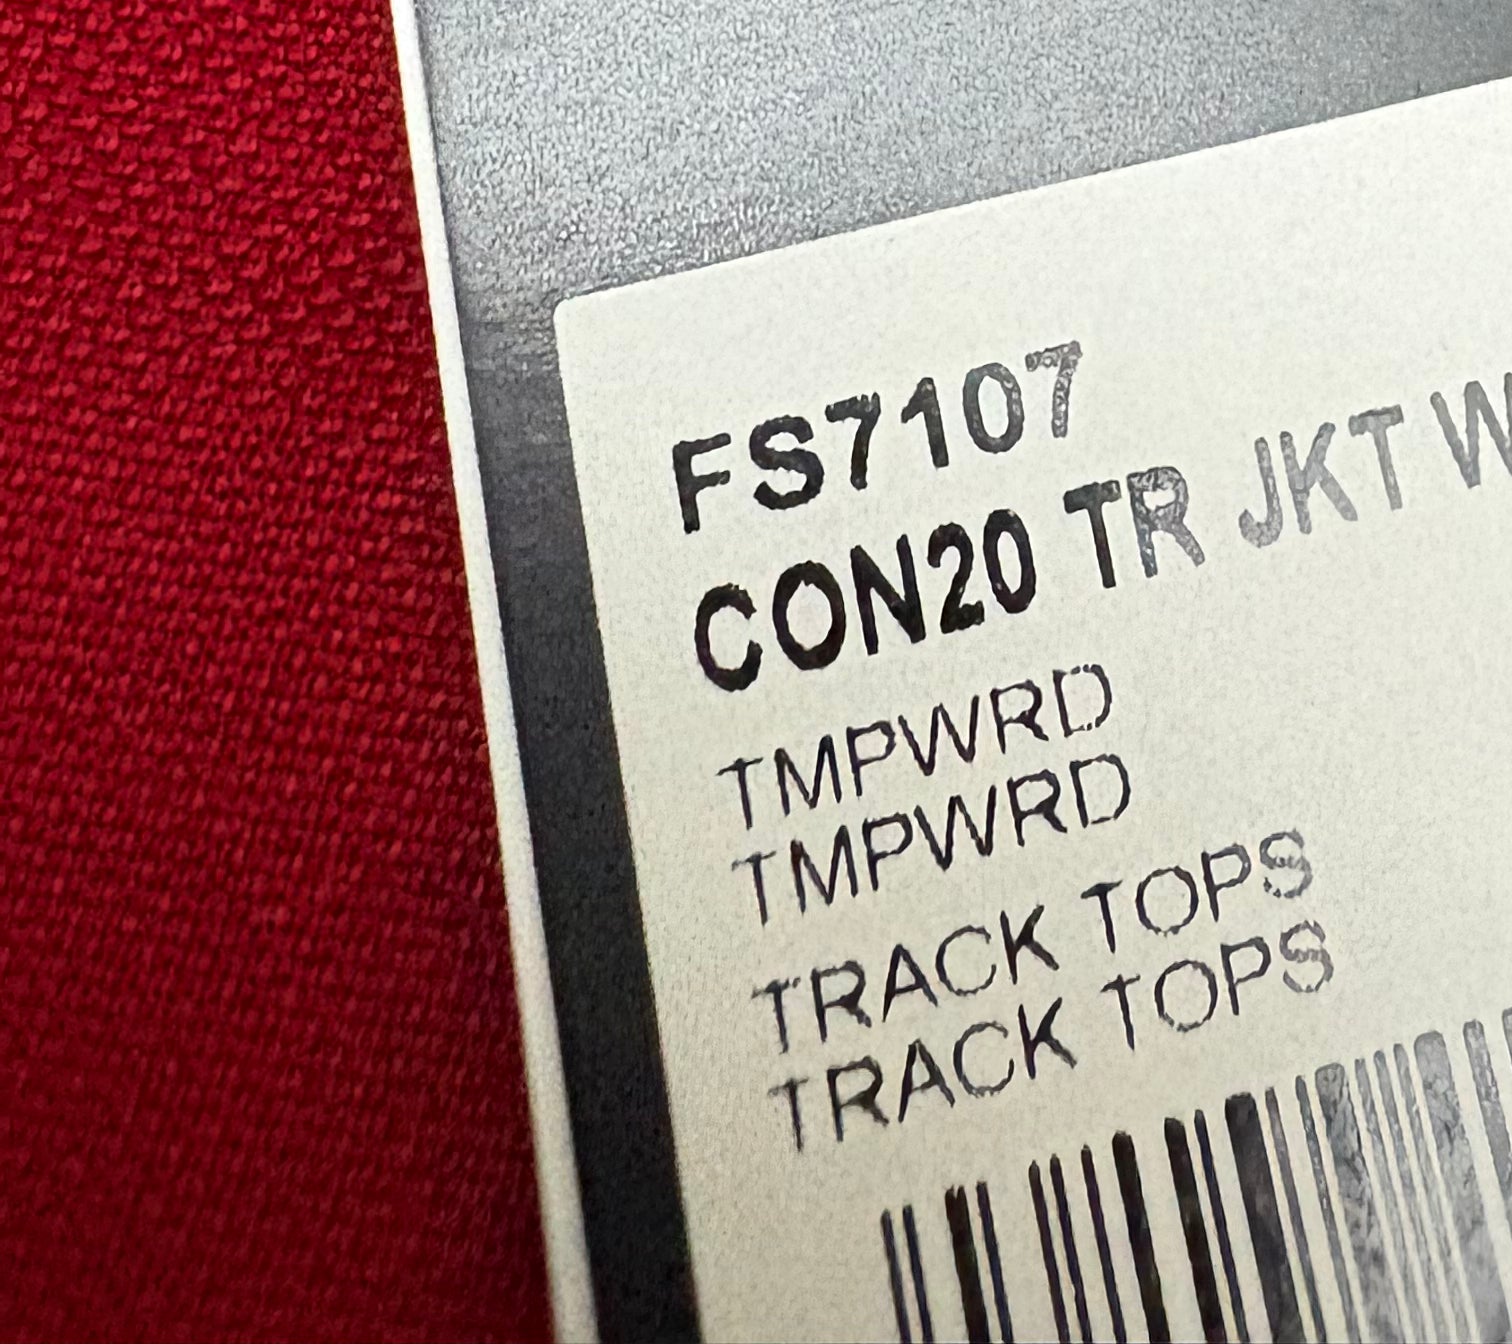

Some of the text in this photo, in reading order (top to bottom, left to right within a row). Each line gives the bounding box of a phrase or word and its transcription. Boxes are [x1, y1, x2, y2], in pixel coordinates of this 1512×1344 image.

[672, 339, 1083, 535] FS7107
[694, 507, 1036, 693] CON20
[1063, 465, 1206, 589] TR
[1237, 403, 1404, 548] JKT
[717, 663, 1114, 830] TMPWRD
[731, 752, 1132, 927] TMPWRD
[752, 828, 1314, 1053] TRACK TOPS
[769, 918, 1336, 1153] TRACK TOPS
